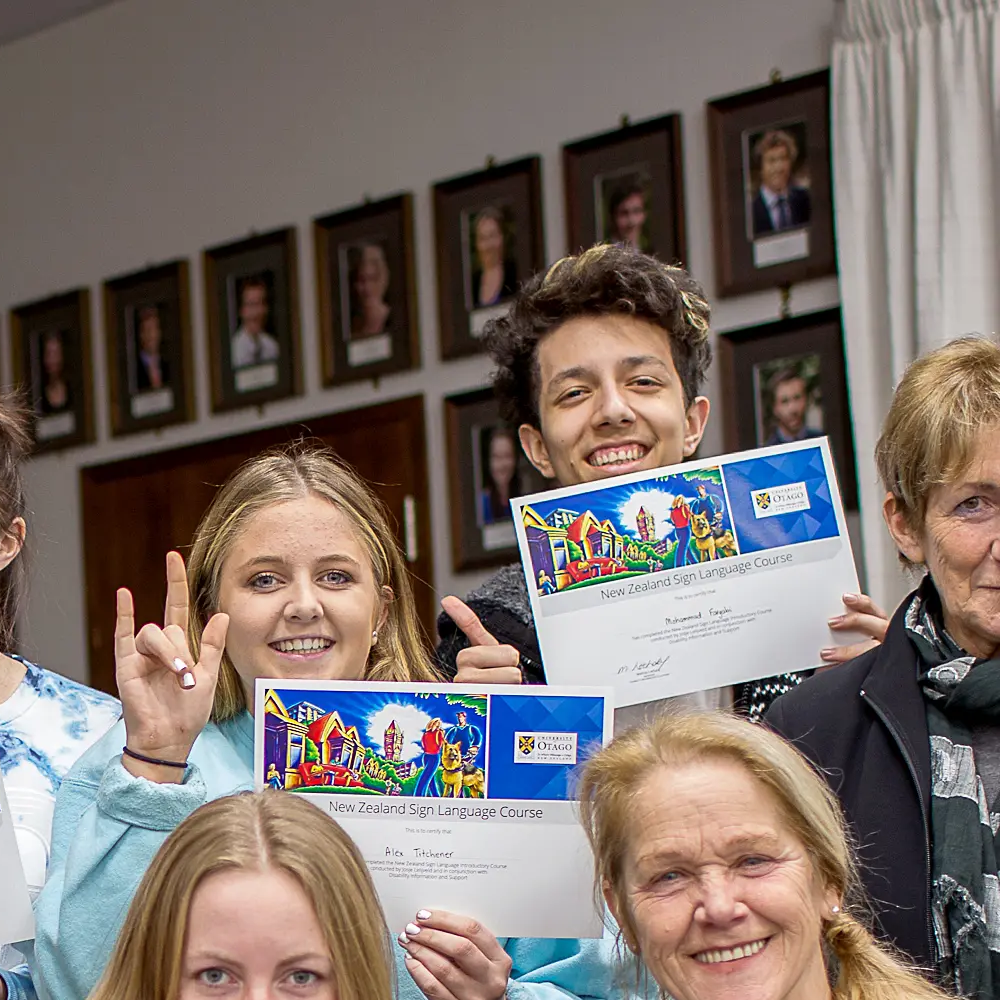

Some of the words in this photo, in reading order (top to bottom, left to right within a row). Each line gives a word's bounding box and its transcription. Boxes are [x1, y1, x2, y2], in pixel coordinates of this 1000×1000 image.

[600, 588, 625, 600] New
[628, 576, 671, 595] Zealand
[673, 573, 697, 586] Sign
[699, 563, 751, 579] Language
[753, 553, 793, 568] Course
[538, 741, 572, 751] OTAGO
[329, 801, 355, 813] New
[358, 802, 406, 814] Zealand
[409, 803, 434, 818] Sign
[438, 804, 497, 820] Language
[499, 806, 543, 819] Course
[385, 846, 404, 857] Alex
[413, 847, 454, 858] Titchener
